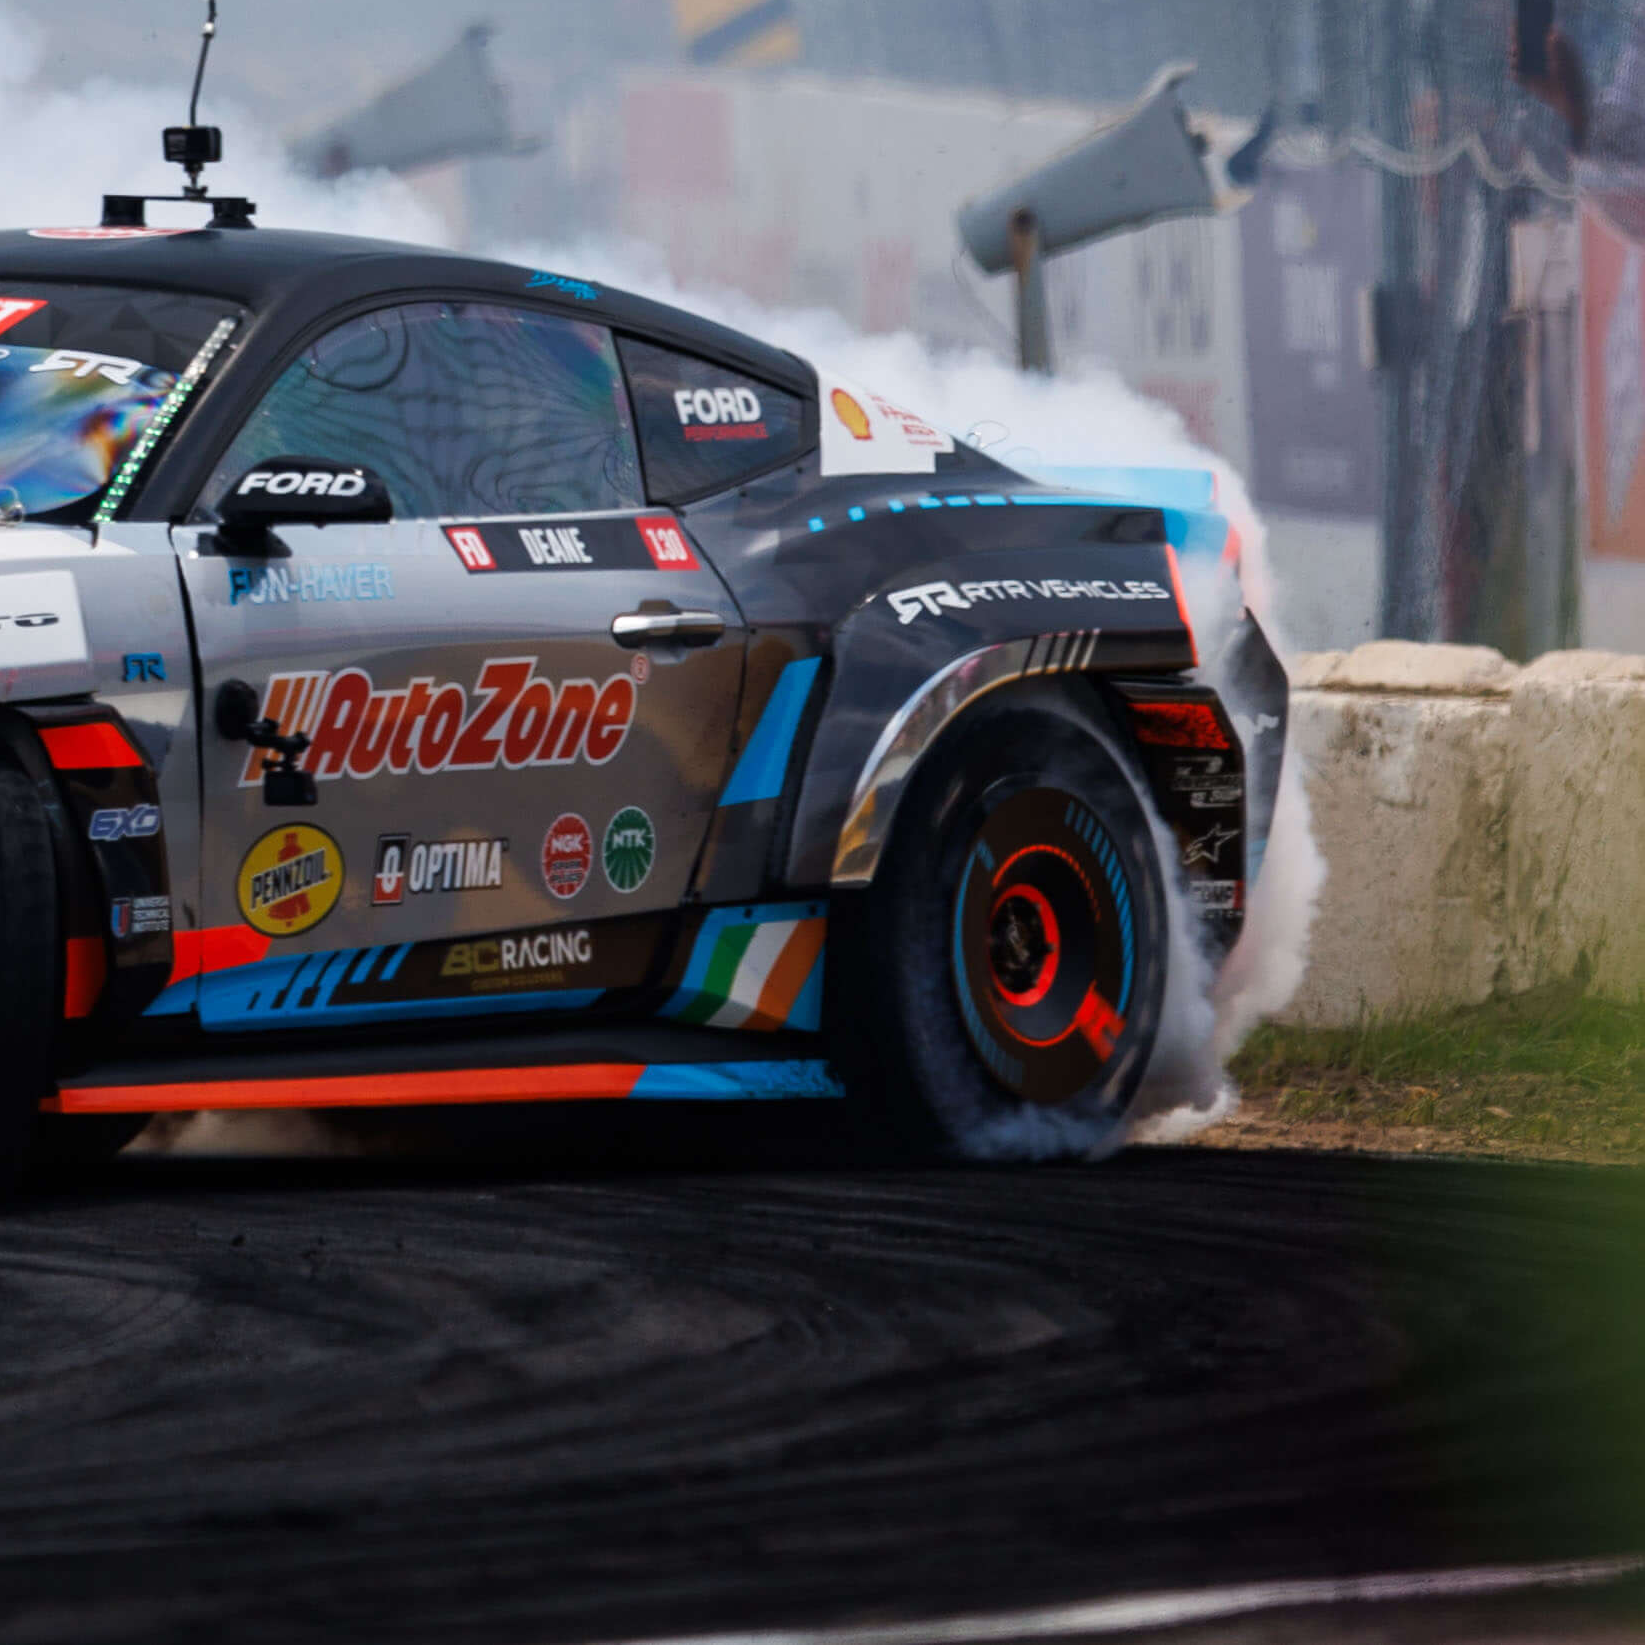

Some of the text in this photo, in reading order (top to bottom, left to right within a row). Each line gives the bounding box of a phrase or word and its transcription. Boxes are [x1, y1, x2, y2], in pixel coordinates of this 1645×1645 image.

[674, 386, 762, 425] FORD
[237, 470, 367, 498] FORD
[449, 525, 690, 569] FD DEANE 130
[228, 562, 396, 606] FUN-HAVER
[962, 579, 1171, 606] RTR VEHICLES
[307, 656, 636, 779] AutoZone
[550, 833, 584, 854] NGK
[612, 828, 647, 850] NTK
[251, 848, 331, 911] PENNZOIL
[409, 840, 504, 893] OPTIMA
[501, 929, 592, 971] RACING
